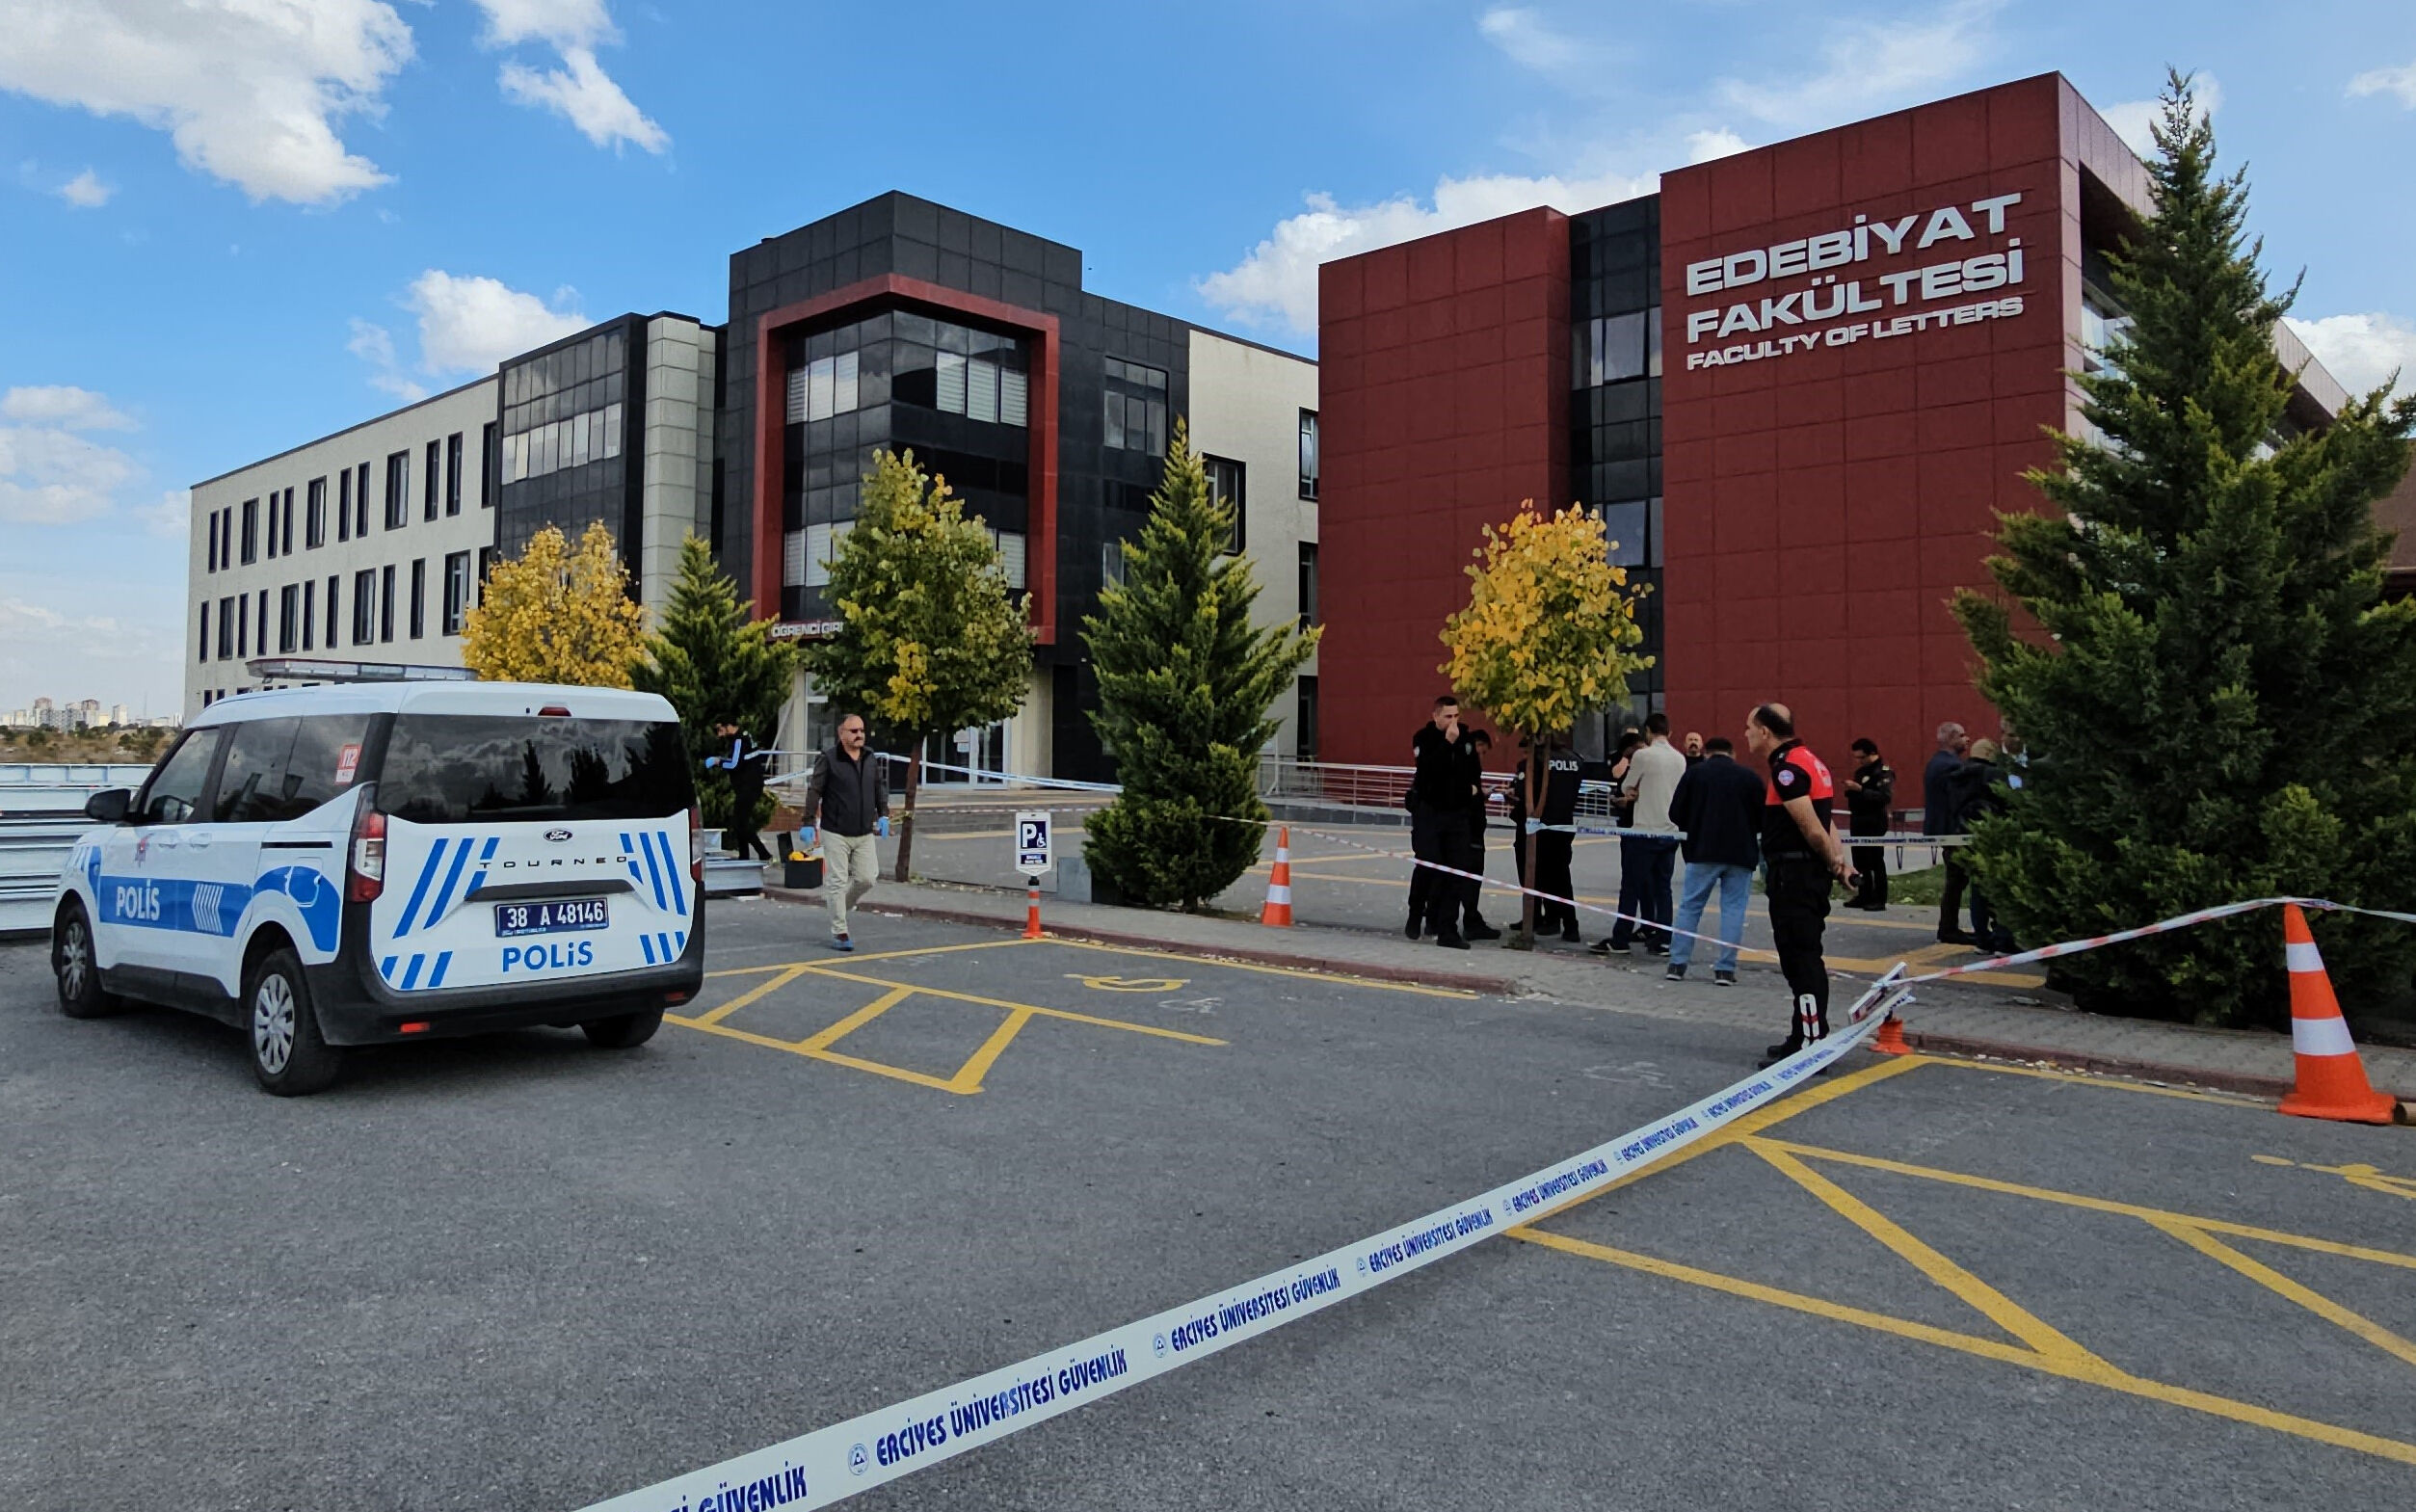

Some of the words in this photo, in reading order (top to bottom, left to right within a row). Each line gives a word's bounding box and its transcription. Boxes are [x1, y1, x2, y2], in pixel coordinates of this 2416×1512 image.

[1686, 193, 2022, 297] EDEBİYAT
[1686, 238, 2023, 344] FAKÜLTESİ
[1686, 331, 1821, 371] FACULTY
[1825, 323, 1869, 347] OF
[1872, 296, 2024, 339] LETTERS
[479, 856, 627, 869] TOURNEO
[1022, 823, 1037, 848] P
[117, 878, 161, 921] POLİS
[507, 907, 528, 928] 38
[540, 906, 551, 926] A
[557, 901, 604, 924] 48146
[1171, 1314, 1218, 1351] ERCİYES
[1219, 1281, 1291, 1332] ÜNİVERSİTESİ
[1291, 1264, 1341, 1303] GÜVENLİK
[876, 1418, 947, 1466] ERCİYES
[950, 1366, 1055, 1437] ÜNİVERSİTESİ
[1058, 1344, 1128, 1395] GÜVENLİK
